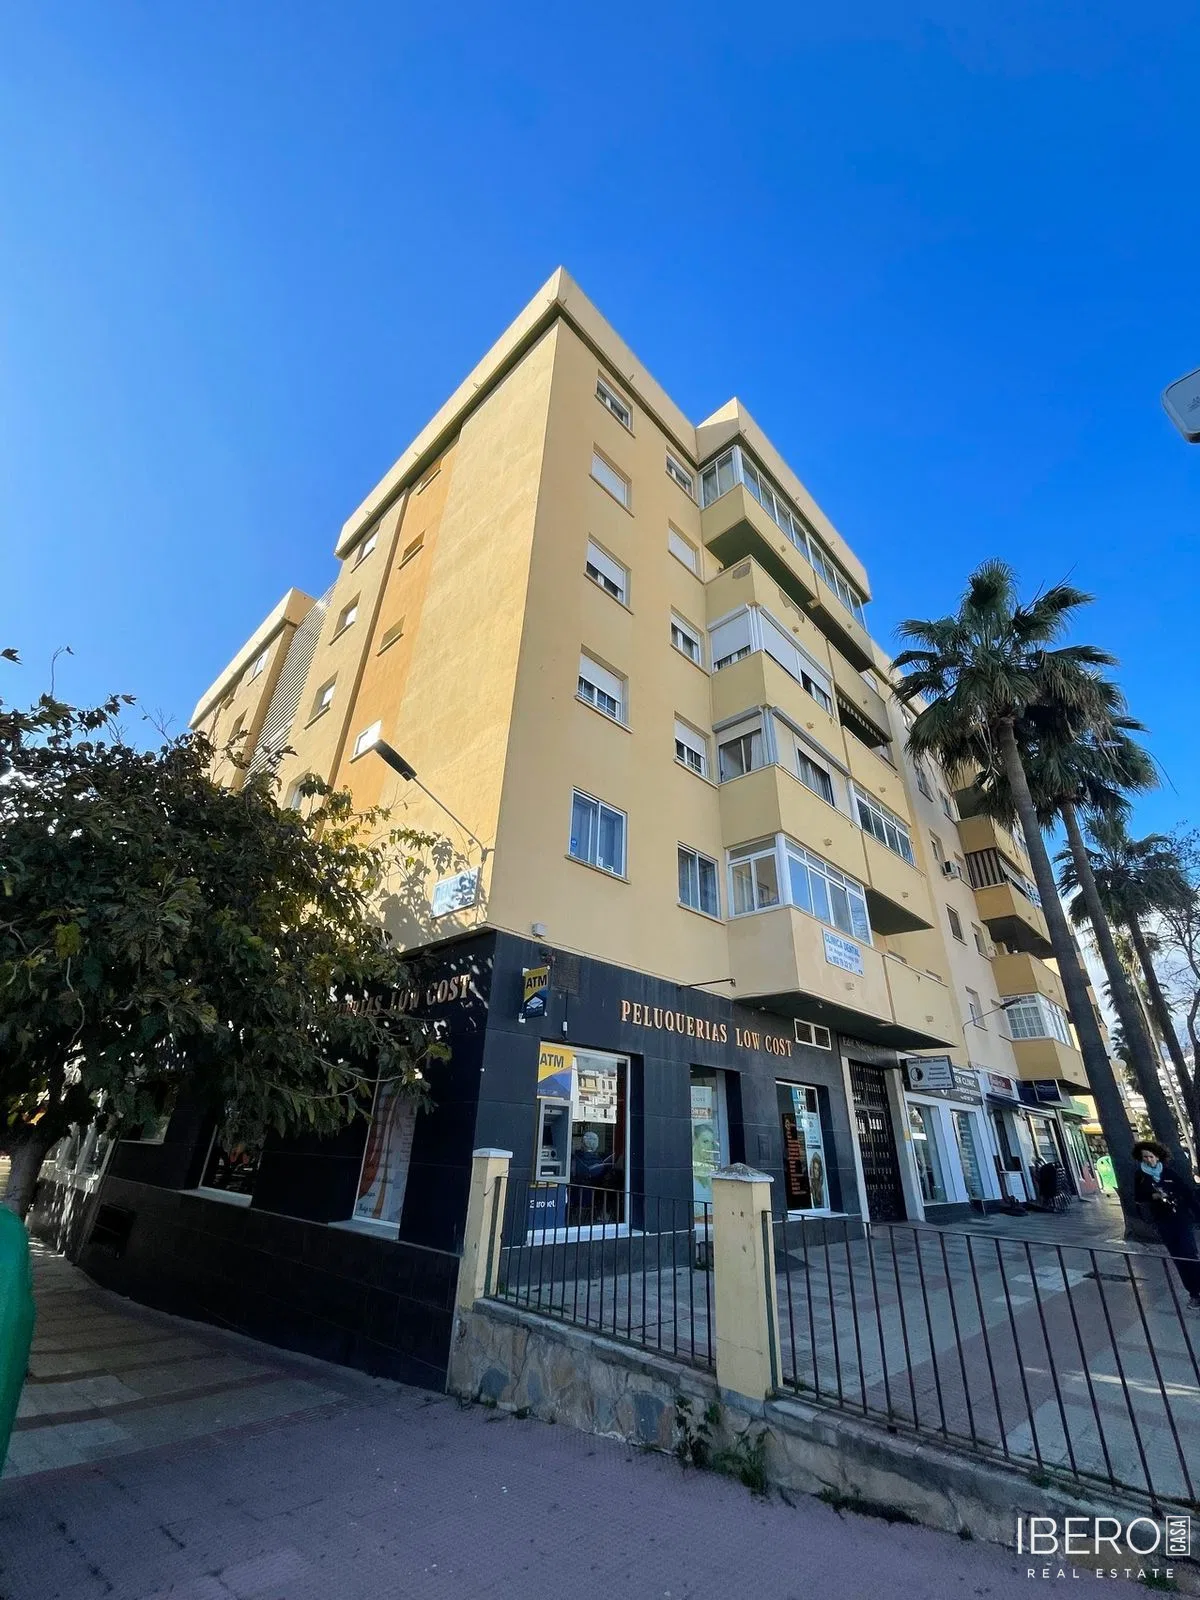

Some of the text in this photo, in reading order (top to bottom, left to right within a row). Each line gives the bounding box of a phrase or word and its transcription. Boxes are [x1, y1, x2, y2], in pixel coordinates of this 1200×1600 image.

[426, 973, 471, 1006] COST
[525, 975, 548, 990] ATM
[620, 999, 793, 1057] PELUQUERIAS LOW COST
[539, 1053, 564, 1068] ATM
